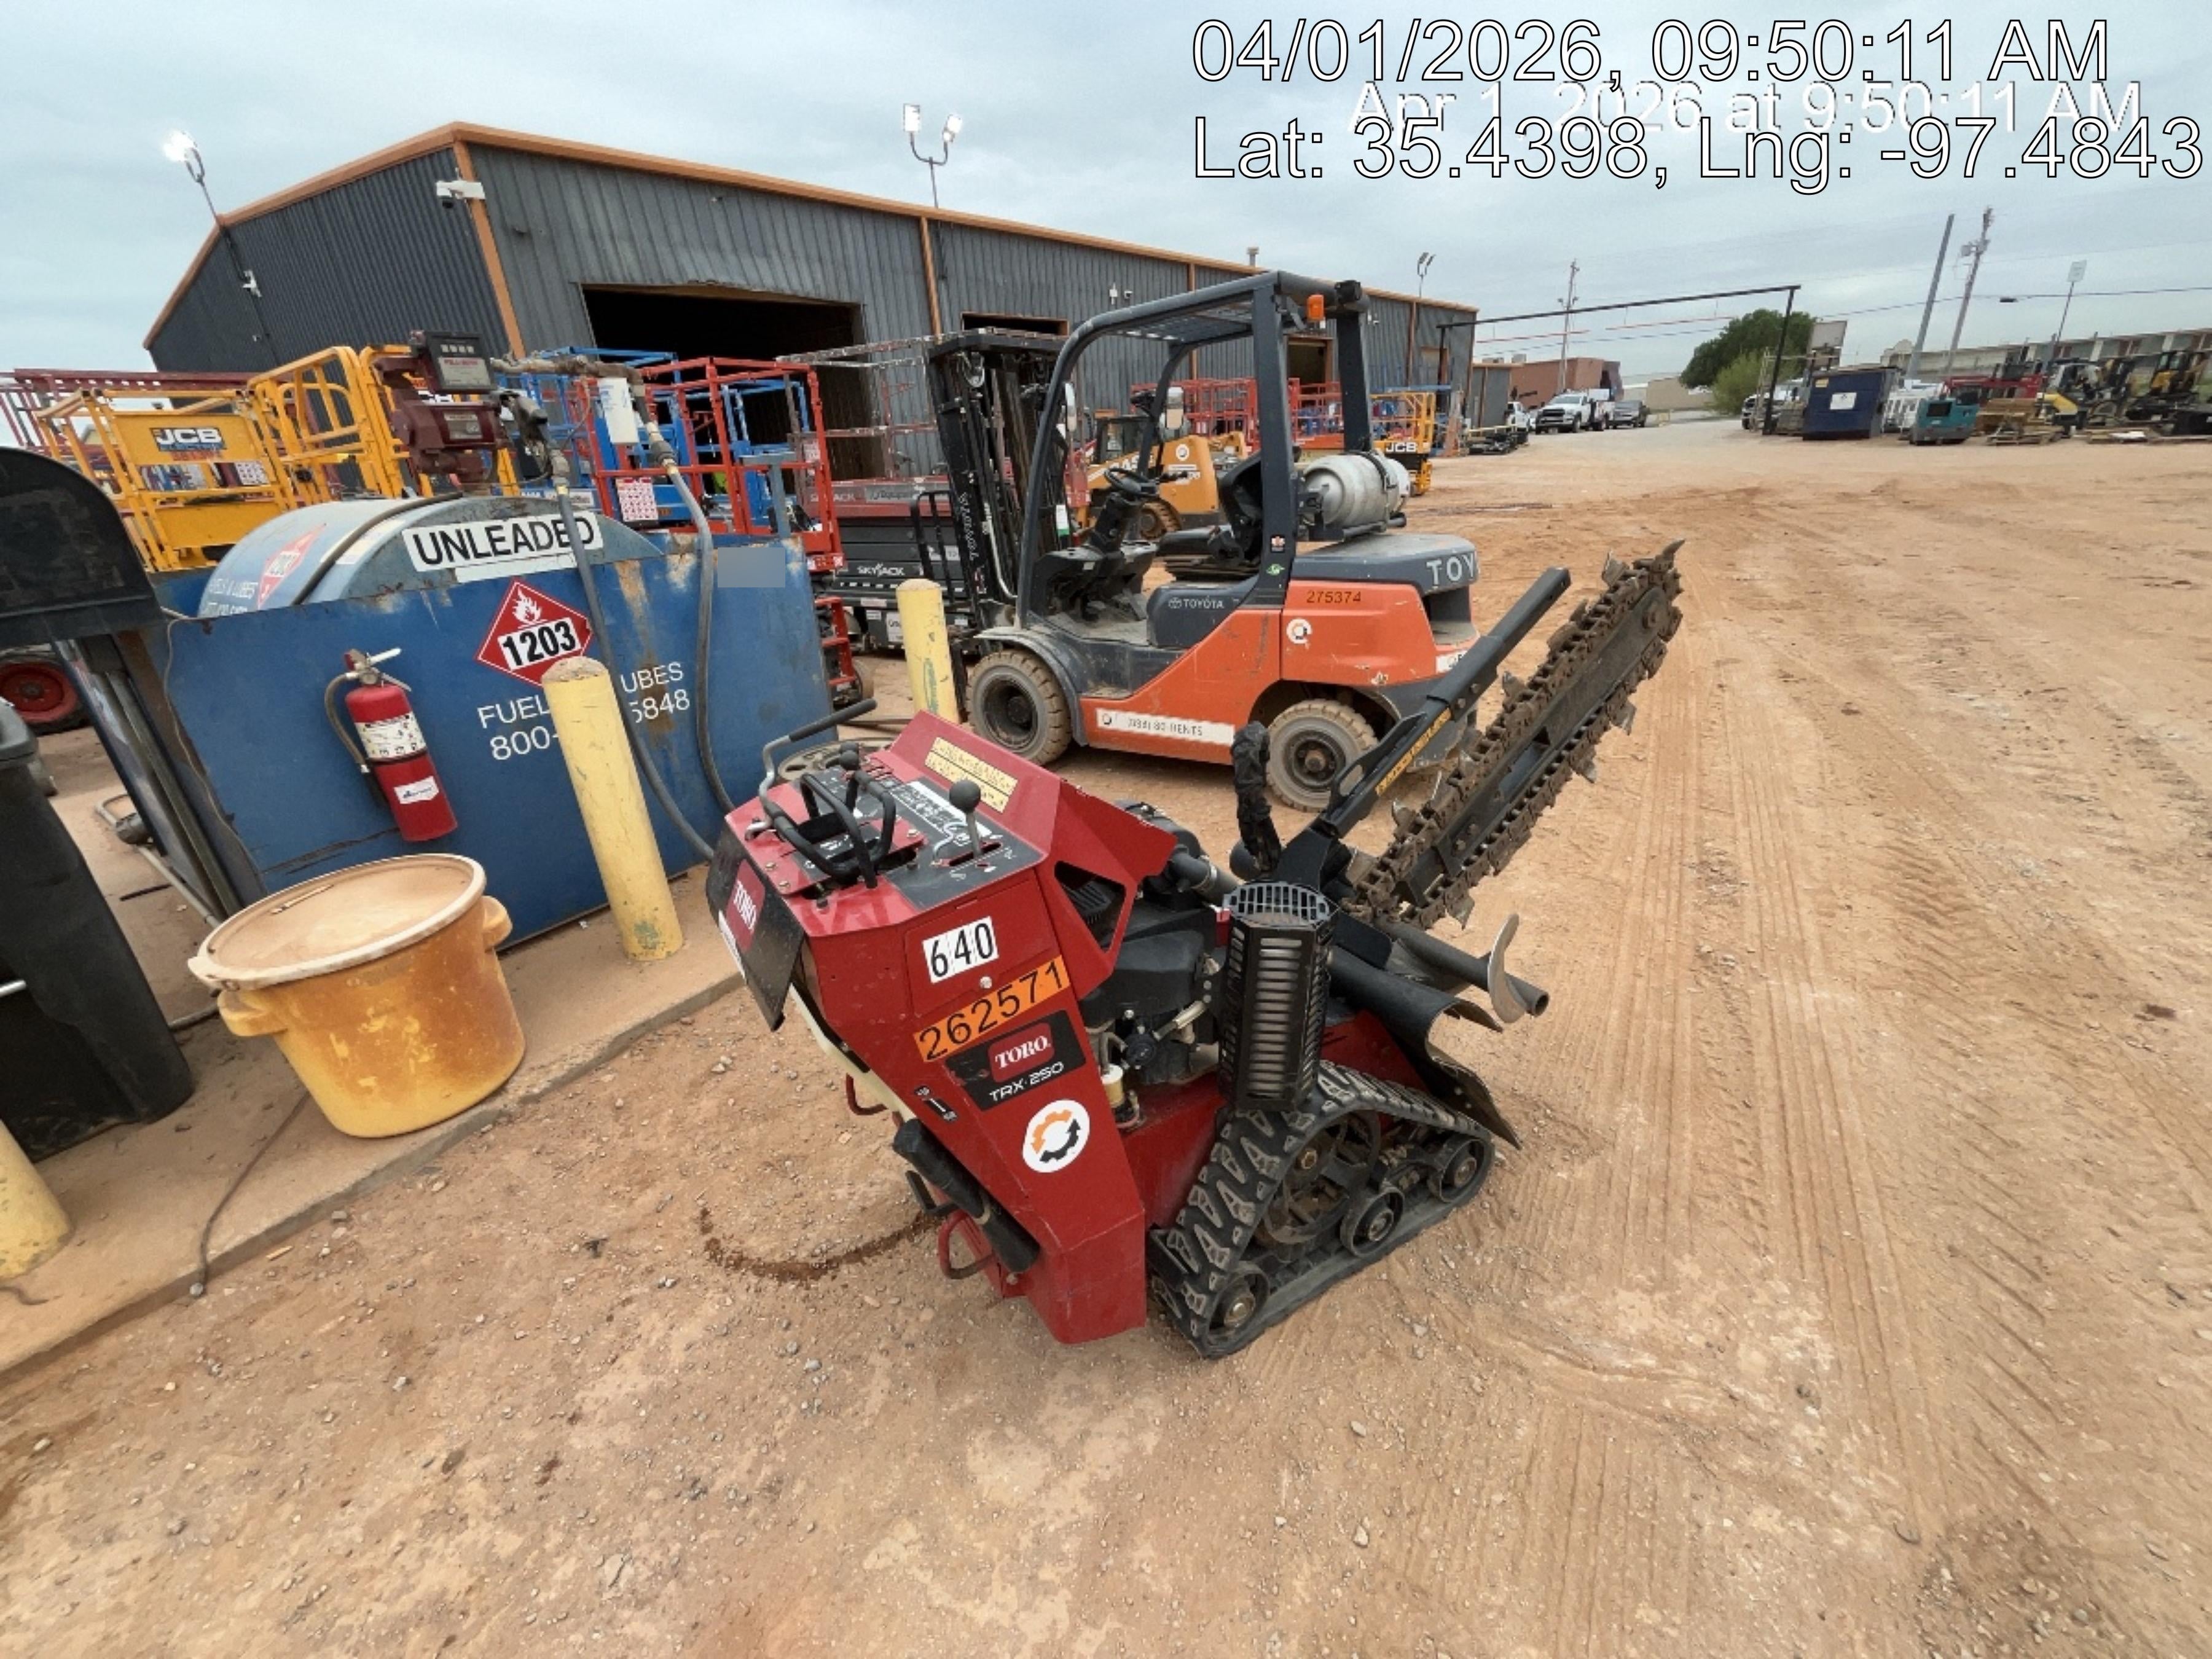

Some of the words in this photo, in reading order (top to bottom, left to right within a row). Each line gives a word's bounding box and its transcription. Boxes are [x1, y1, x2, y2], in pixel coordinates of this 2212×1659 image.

[154, 428, 222, 444] JCB
[1386, 442, 1418, 452] JCB
[412, 517, 595, 565] UNLEADED
[857, 563, 906, 577] SKYJACK
[1183, 598, 1225, 609] TOYOTA
[1306, 590, 1362, 604] 275374
[502, 621, 576, 666] 1203
[620, 662, 684, 693] UBES
[930, 922, 995, 978] 640
[919, 961, 1062, 1061] 262571
[994, 1035, 1048, 1069] TORO
